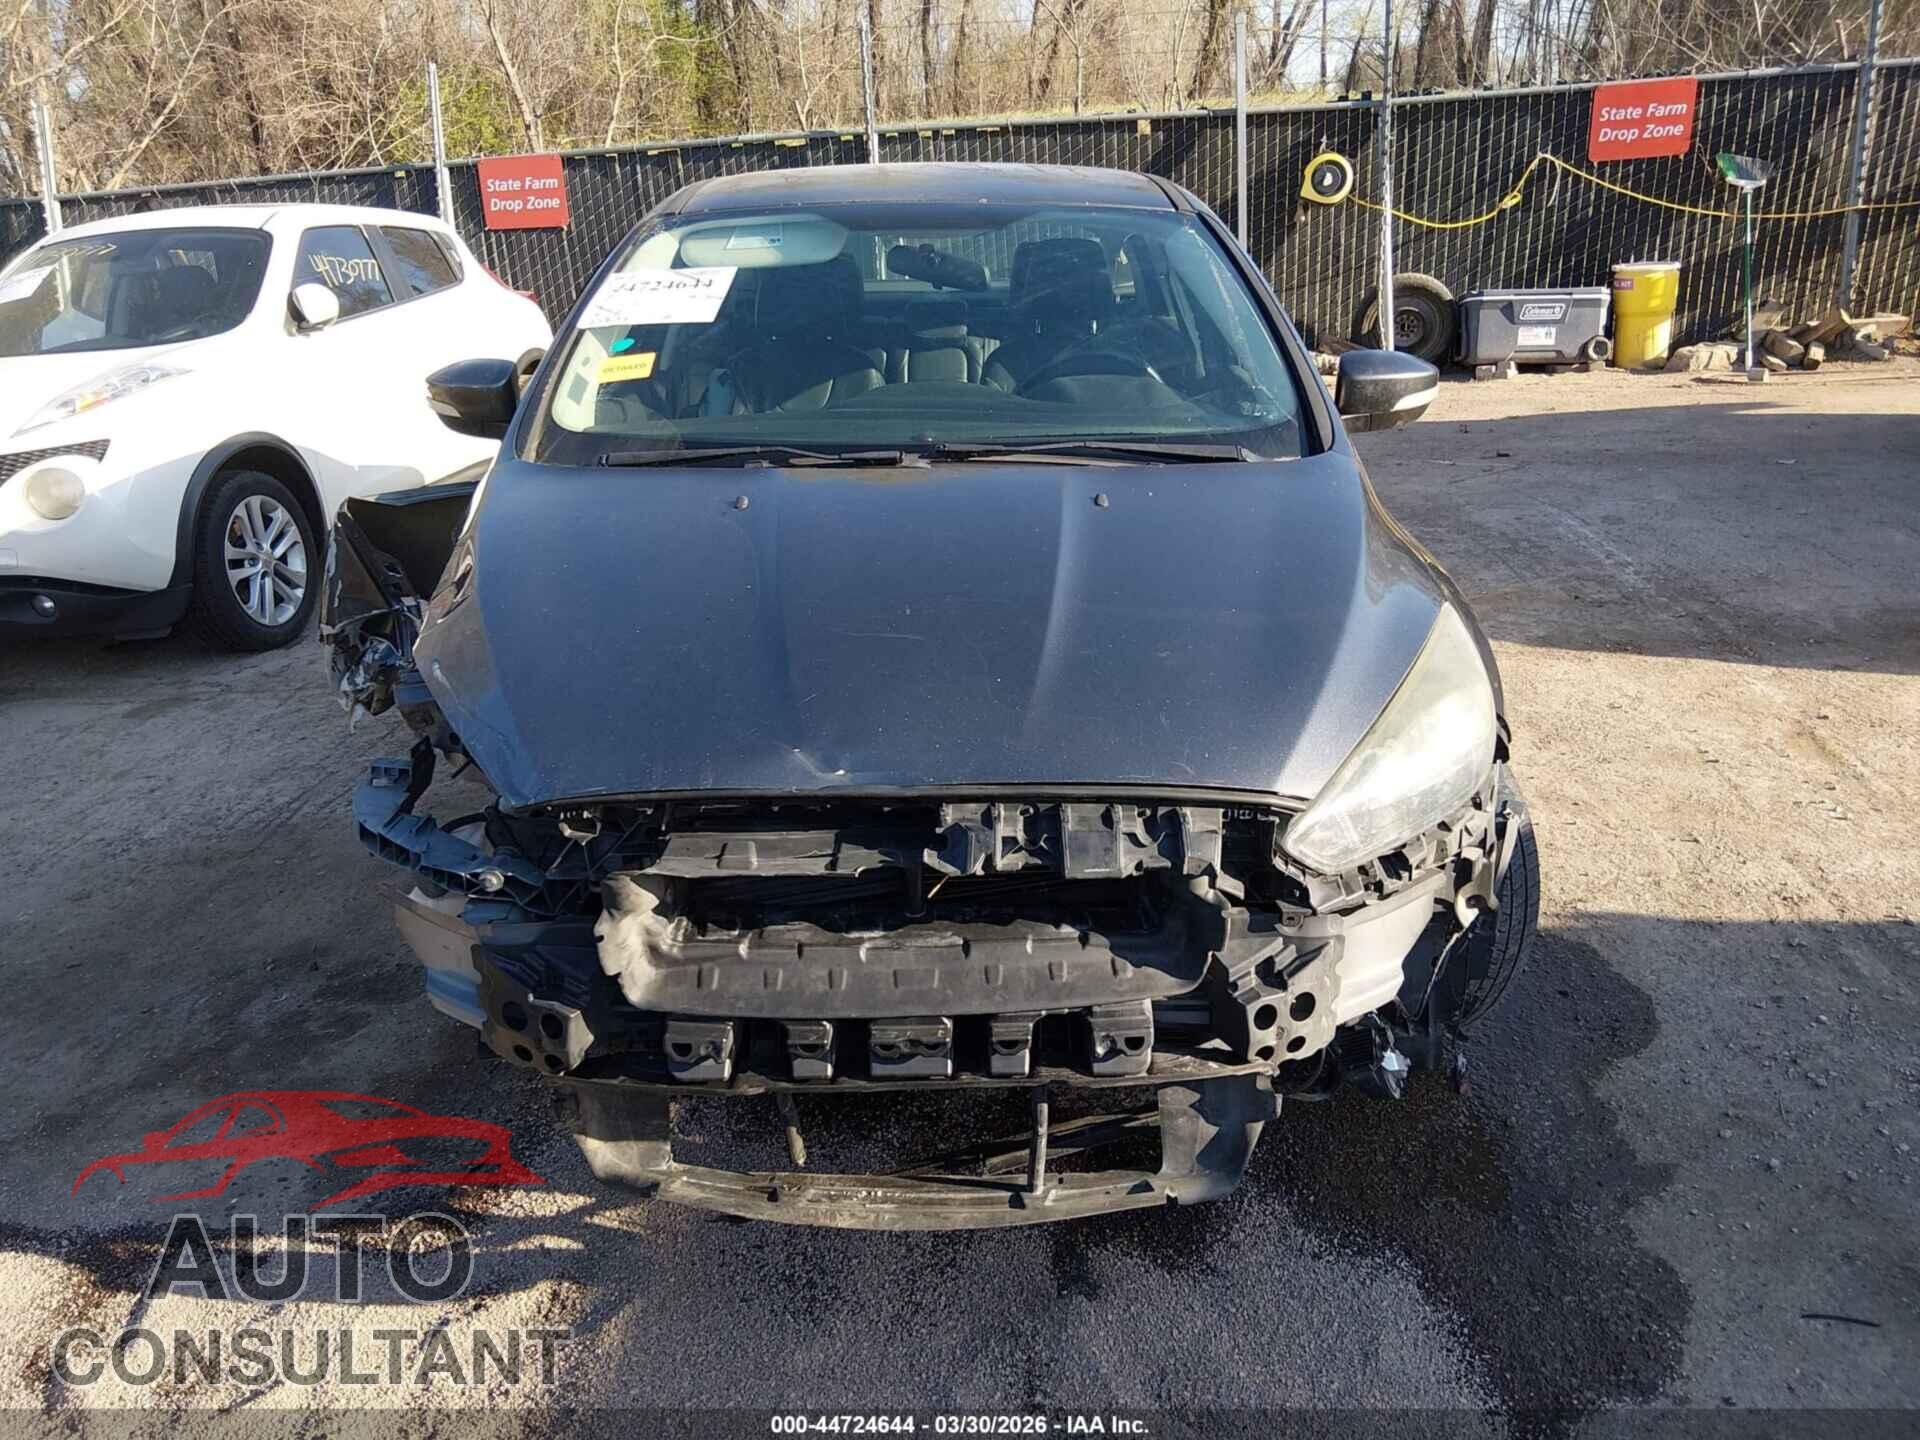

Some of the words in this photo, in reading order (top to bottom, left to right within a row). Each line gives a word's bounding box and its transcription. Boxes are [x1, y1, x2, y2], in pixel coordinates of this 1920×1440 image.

[1600, 106, 1642, 122] State
[1646, 103, 1688, 118] Farm
[1598, 127, 1639, 143] Drop
[1642, 124, 1684, 139] Zone
[487, 178, 521, 192] State
[524, 176, 558, 190] Farm
[490, 198, 523, 213] Drop
[526, 196, 560, 210] Zone
